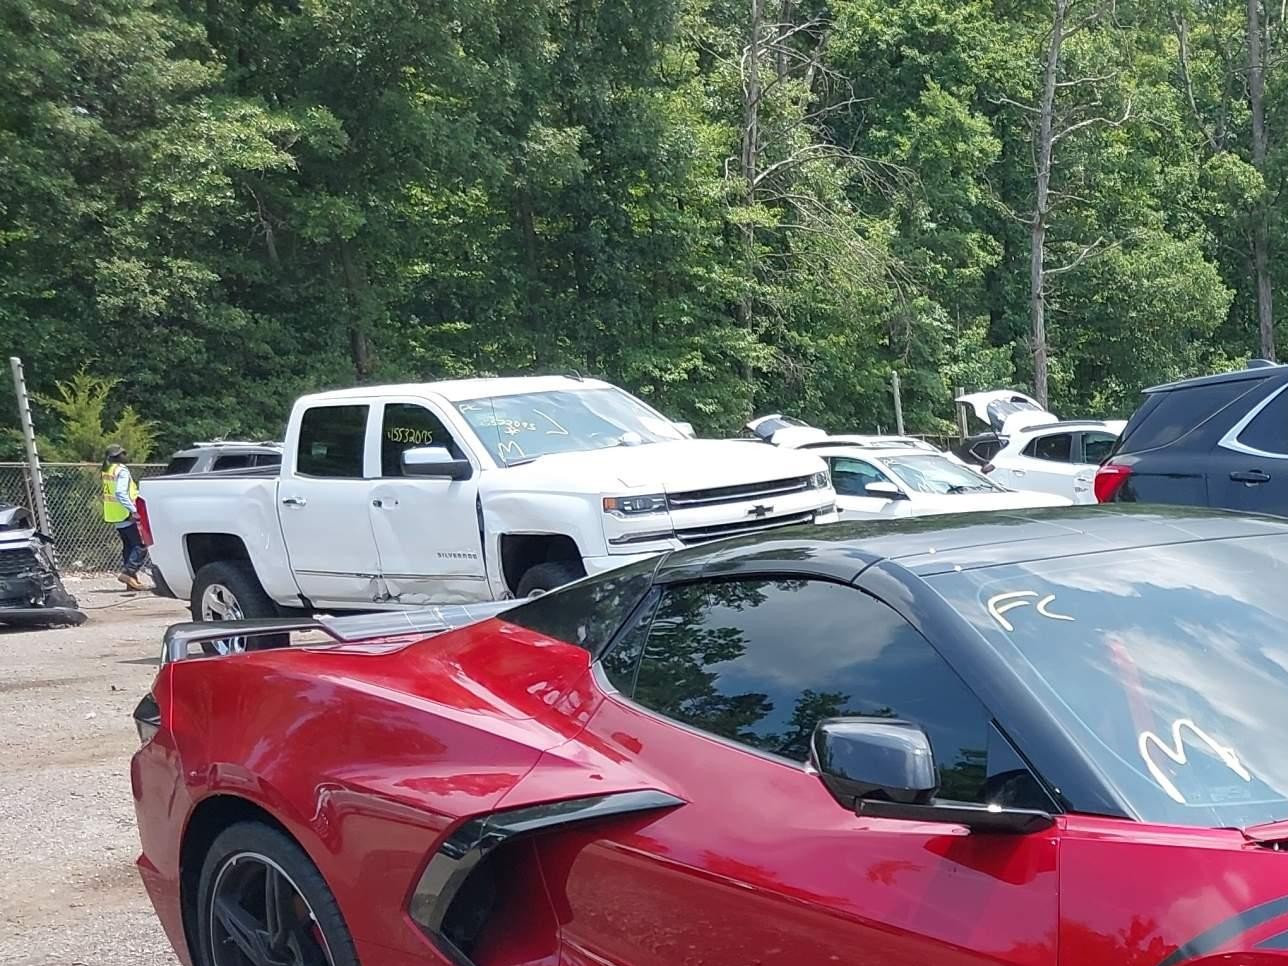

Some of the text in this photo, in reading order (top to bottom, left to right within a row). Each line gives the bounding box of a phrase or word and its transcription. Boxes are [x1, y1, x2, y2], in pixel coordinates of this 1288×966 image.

[498, 441, 527, 462] M
[987, 590, 1076, 632] FC
[1138, 719, 1251, 804] M
